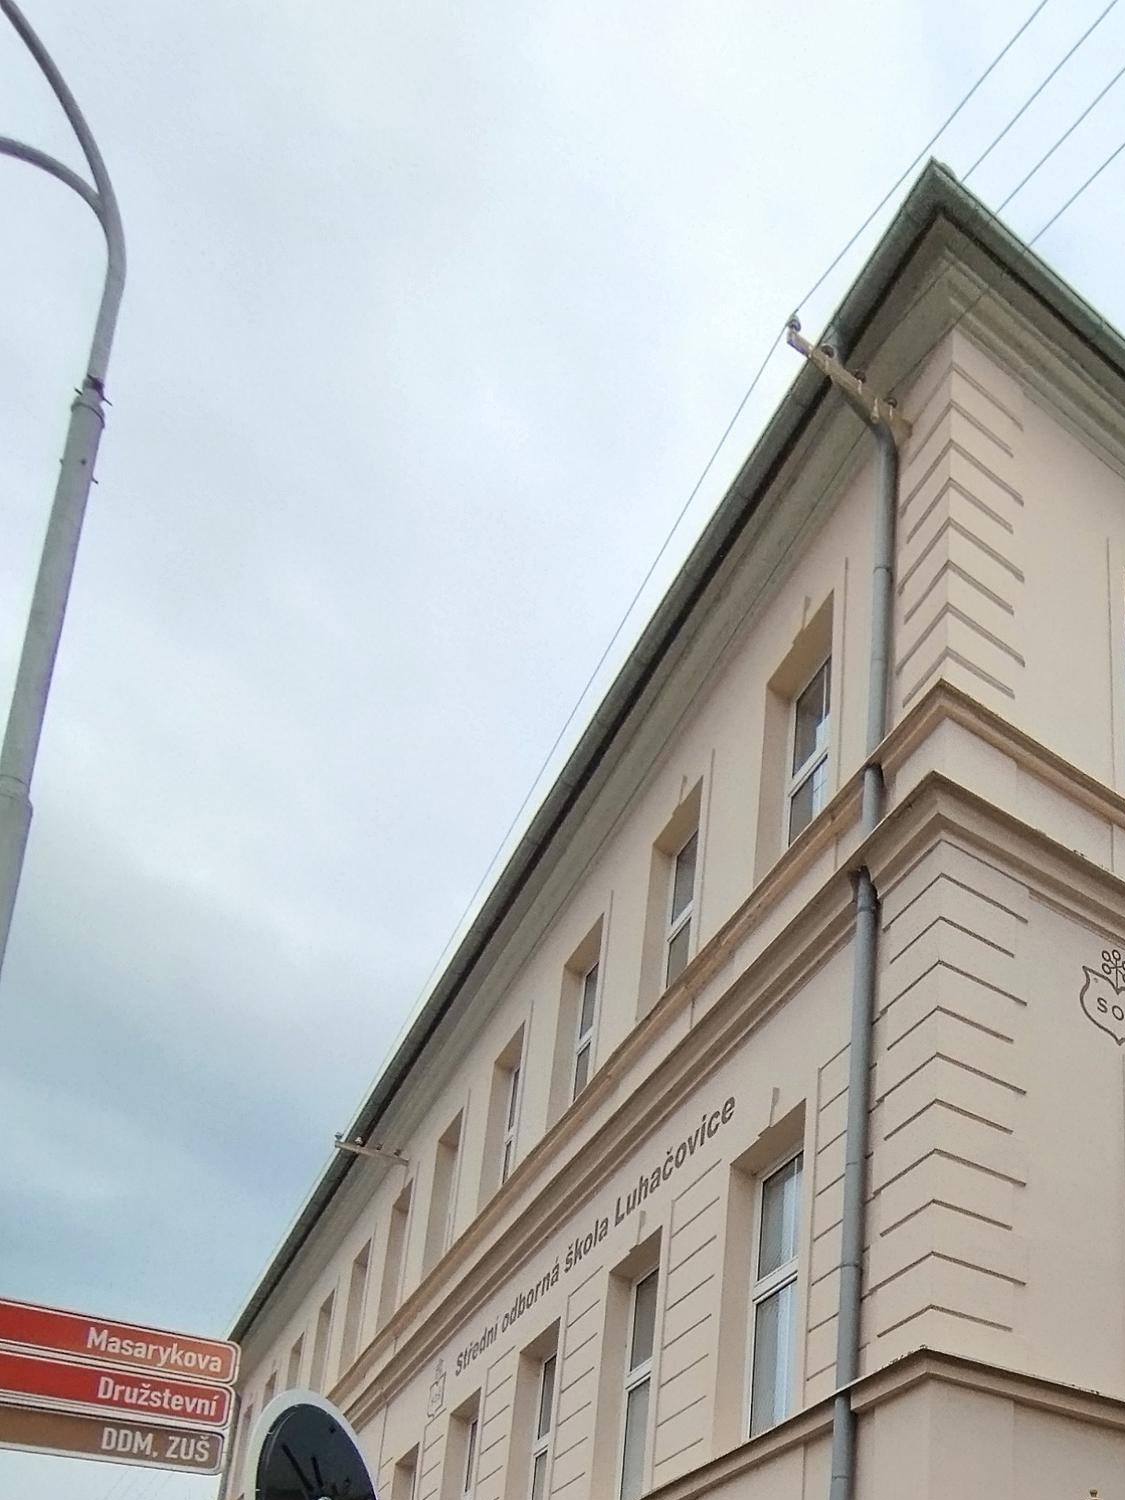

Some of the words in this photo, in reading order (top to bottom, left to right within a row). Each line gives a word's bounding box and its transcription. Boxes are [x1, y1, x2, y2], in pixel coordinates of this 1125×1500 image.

[455, 1316, 500, 1377] Střední
[502, 1259, 560, 1333] odborná
[564, 1216, 609, 1273] škola
[614, 1096, 736, 1227] Luhačovice
[86, 1327, 222, 1372] Masarykova
[98, 1376, 219, 1416] Družstevní
[165, 1436, 210, 1462] ZUŠ
